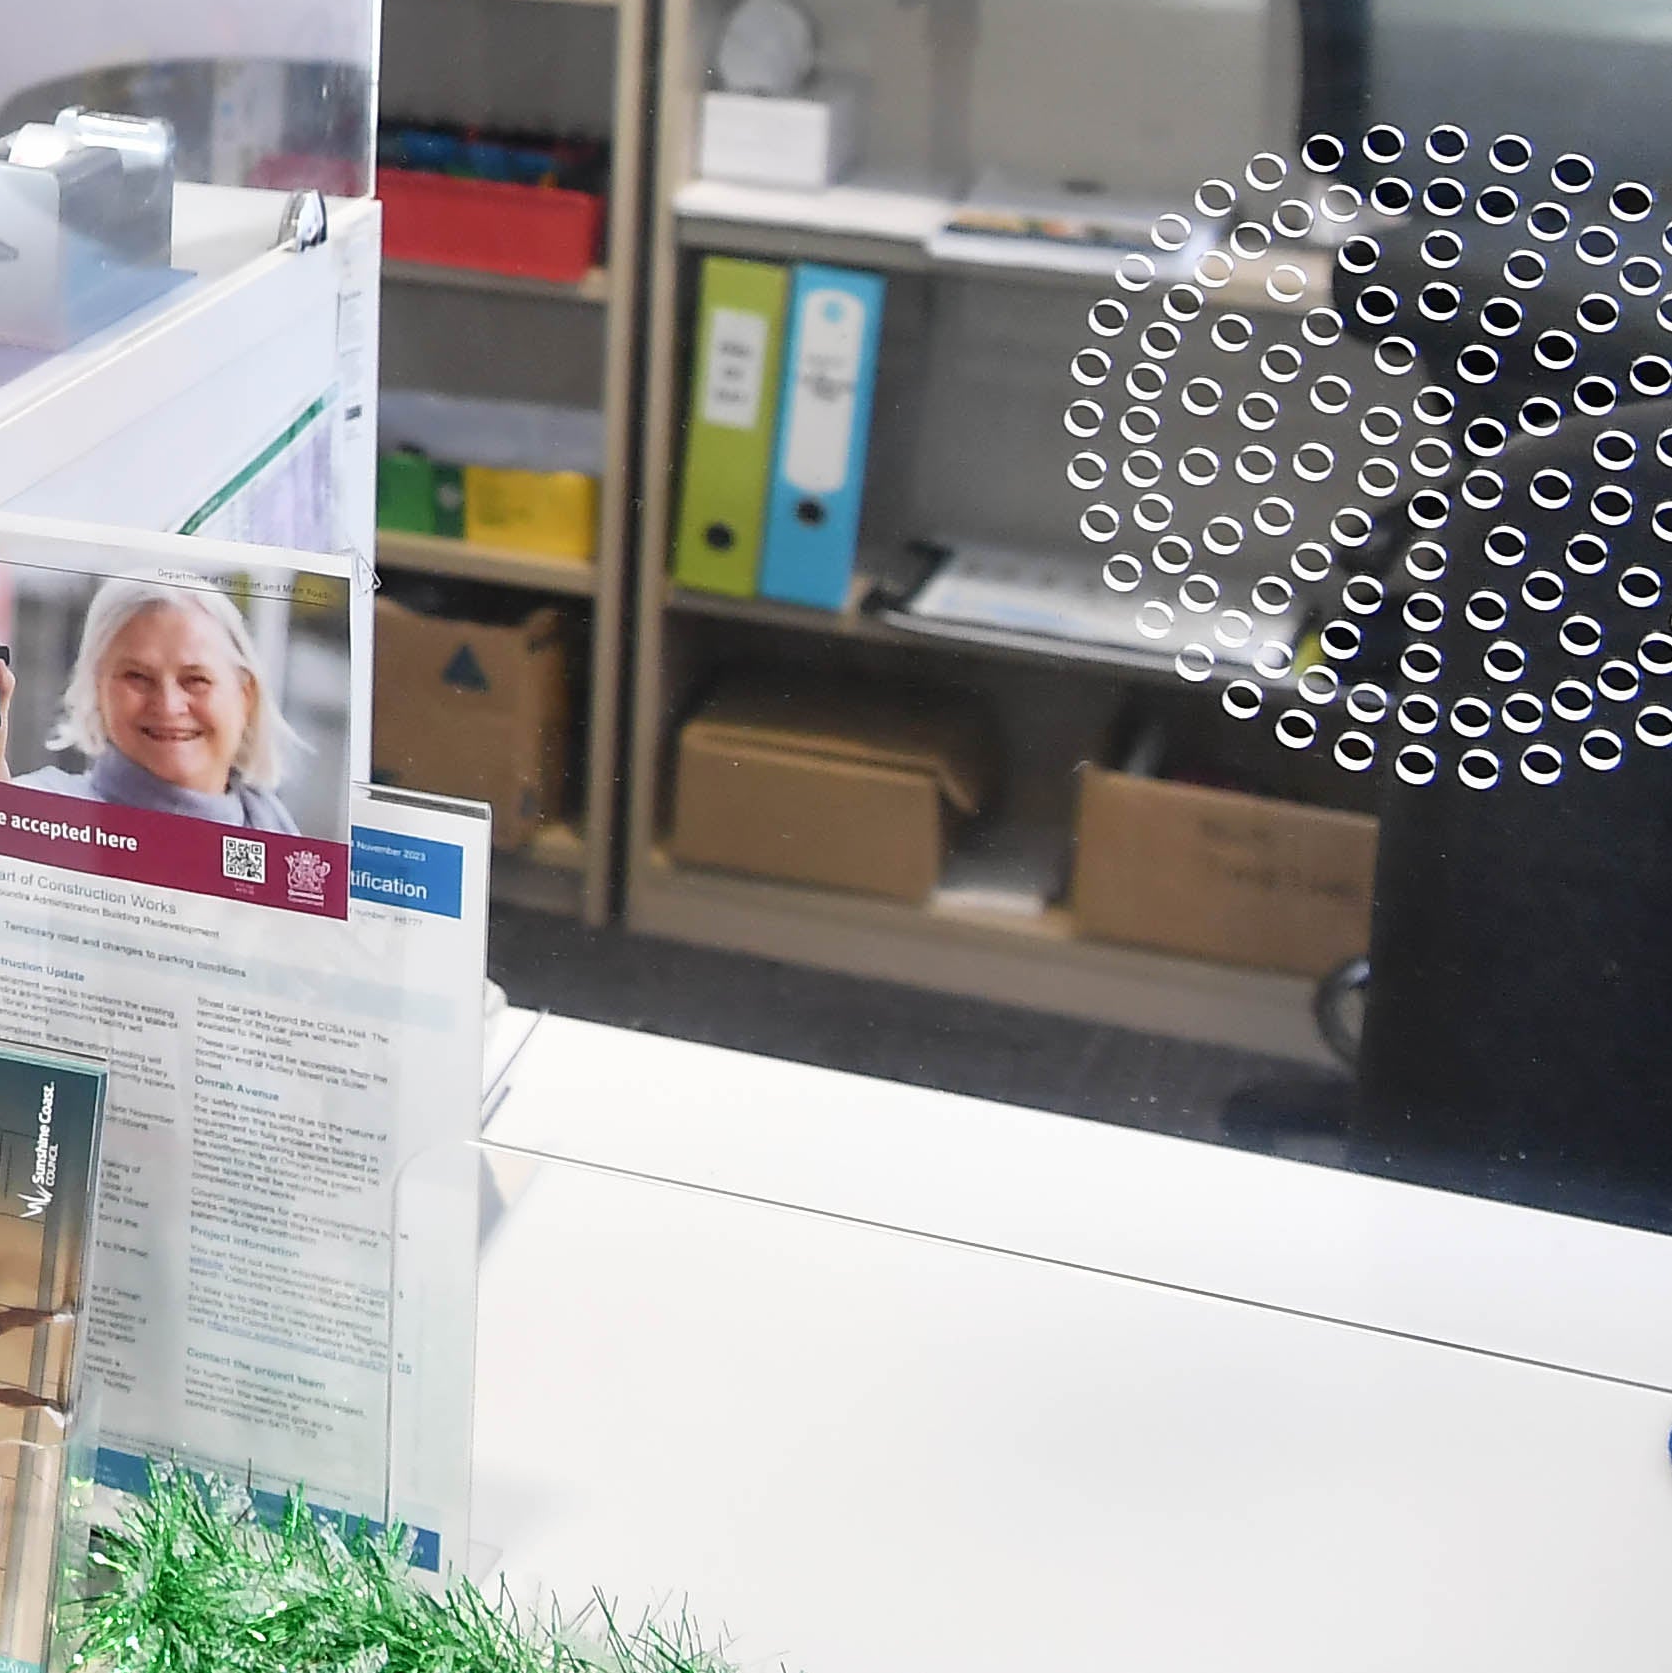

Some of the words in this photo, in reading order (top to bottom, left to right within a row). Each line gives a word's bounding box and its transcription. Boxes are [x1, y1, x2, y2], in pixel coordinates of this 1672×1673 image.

[10, 813, 90, 846] accepted
[95, 826, 137, 851] here
[356, 839, 400, 856] November
[402, 848, 426, 862] 2023
[20, 871, 33, 887] of
[37, 875, 126, 906] Construction
[130, 894, 177, 916] Works
[46, 965, 84, 983] Update
[32, 1121, 51, 1185] Sunshine
[45, 1144, 59, 1186] COUNCIL
